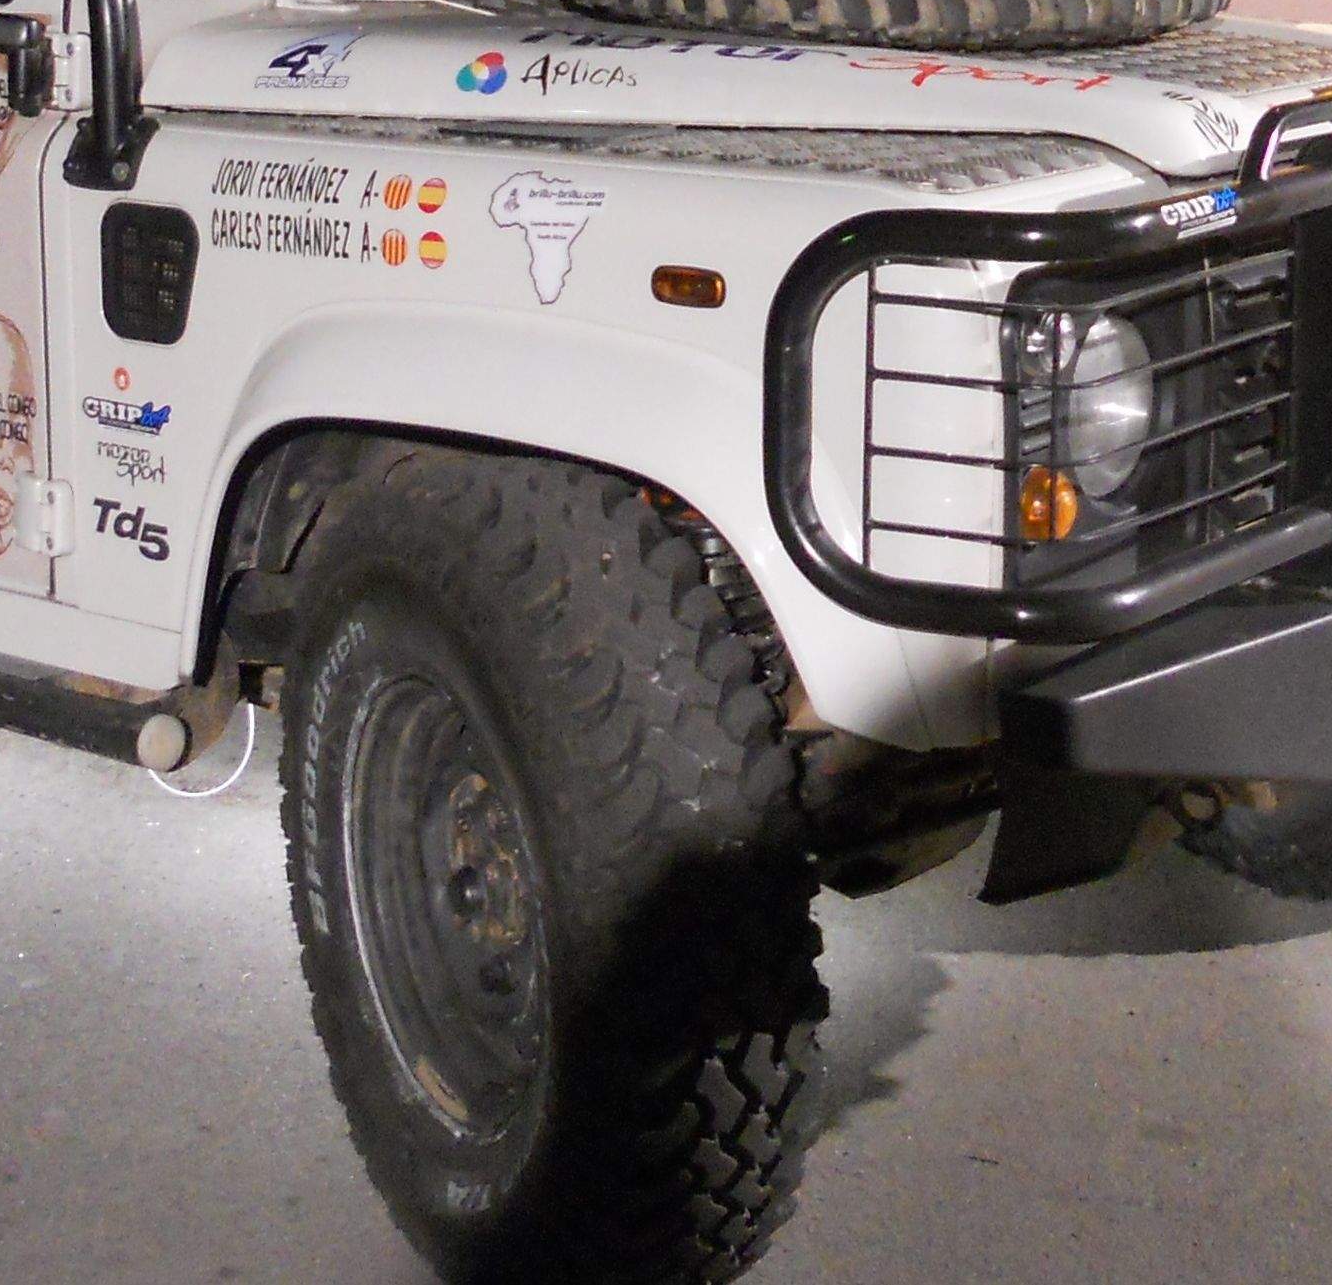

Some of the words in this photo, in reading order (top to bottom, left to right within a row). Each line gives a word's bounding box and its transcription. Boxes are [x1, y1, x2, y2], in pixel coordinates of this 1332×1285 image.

[211, 158, 260, 199] JORDI
[258, 157, 349, 204] FERNÁNDEZ
[211, 207, 262, 251] CARLES
[267, 207, 351, 260] FERNÁNDEZ
[1160, 194, 1216, 226] GRIP
[83, 396, 143, 425] GRIP
[93, 496, 171, 562] Td5
